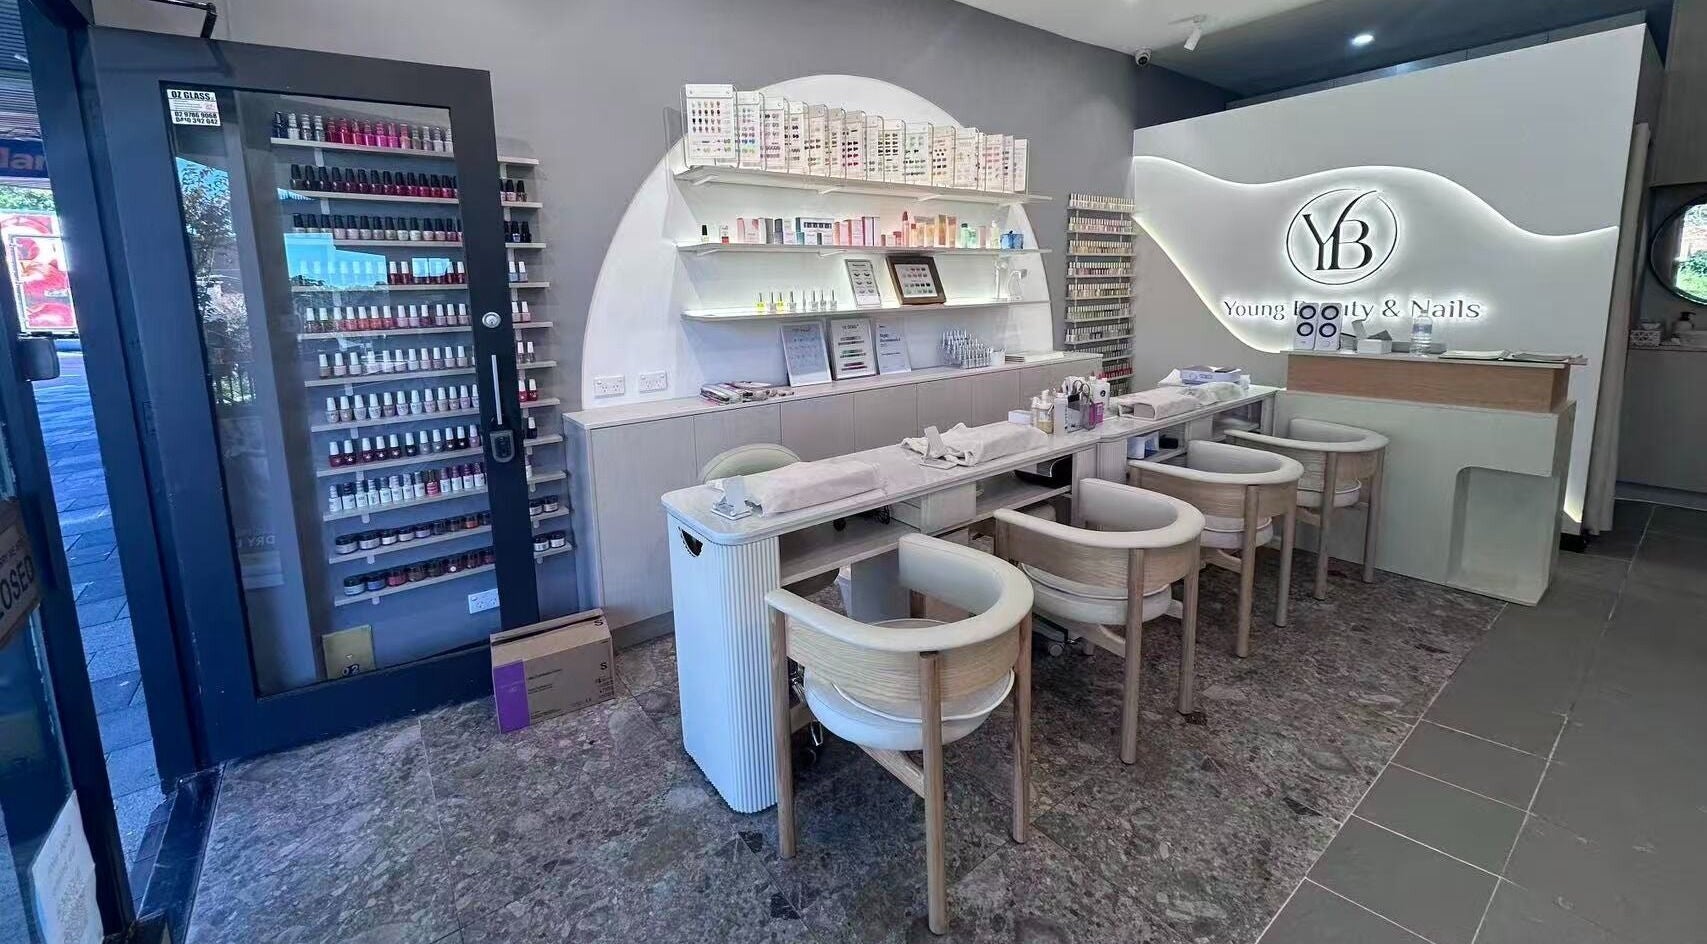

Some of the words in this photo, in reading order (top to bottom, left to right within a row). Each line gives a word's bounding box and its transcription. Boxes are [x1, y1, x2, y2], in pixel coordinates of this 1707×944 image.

[171, 90, 182, 99] OZ
[183, 91, 211, 101] GLASS
[1223, 300, 1286, 321] Young
[1381, 299, 1401, 318] &
[1411, 299, 1481, 319] Nails
[600, 661, 608, 671] S
